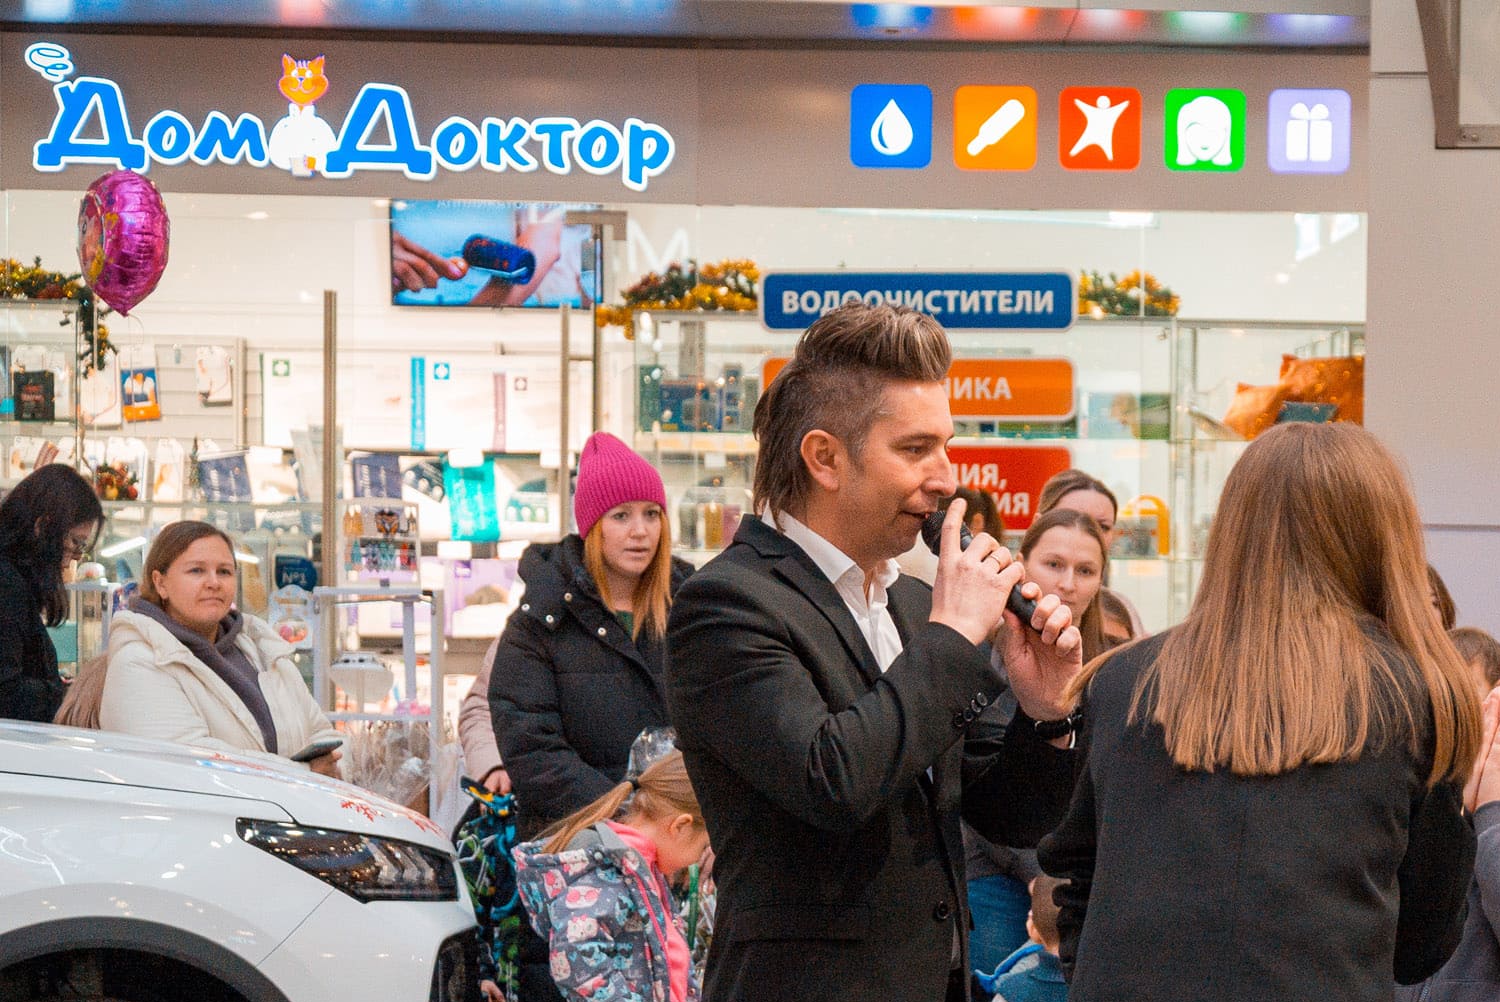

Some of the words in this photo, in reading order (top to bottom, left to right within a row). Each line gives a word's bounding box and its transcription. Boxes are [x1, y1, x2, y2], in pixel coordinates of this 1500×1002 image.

[34, 77, 270, 172] Дом
[323, 83, 675, 191] Доктор
[944, 376, 1012, 400] ИКА
